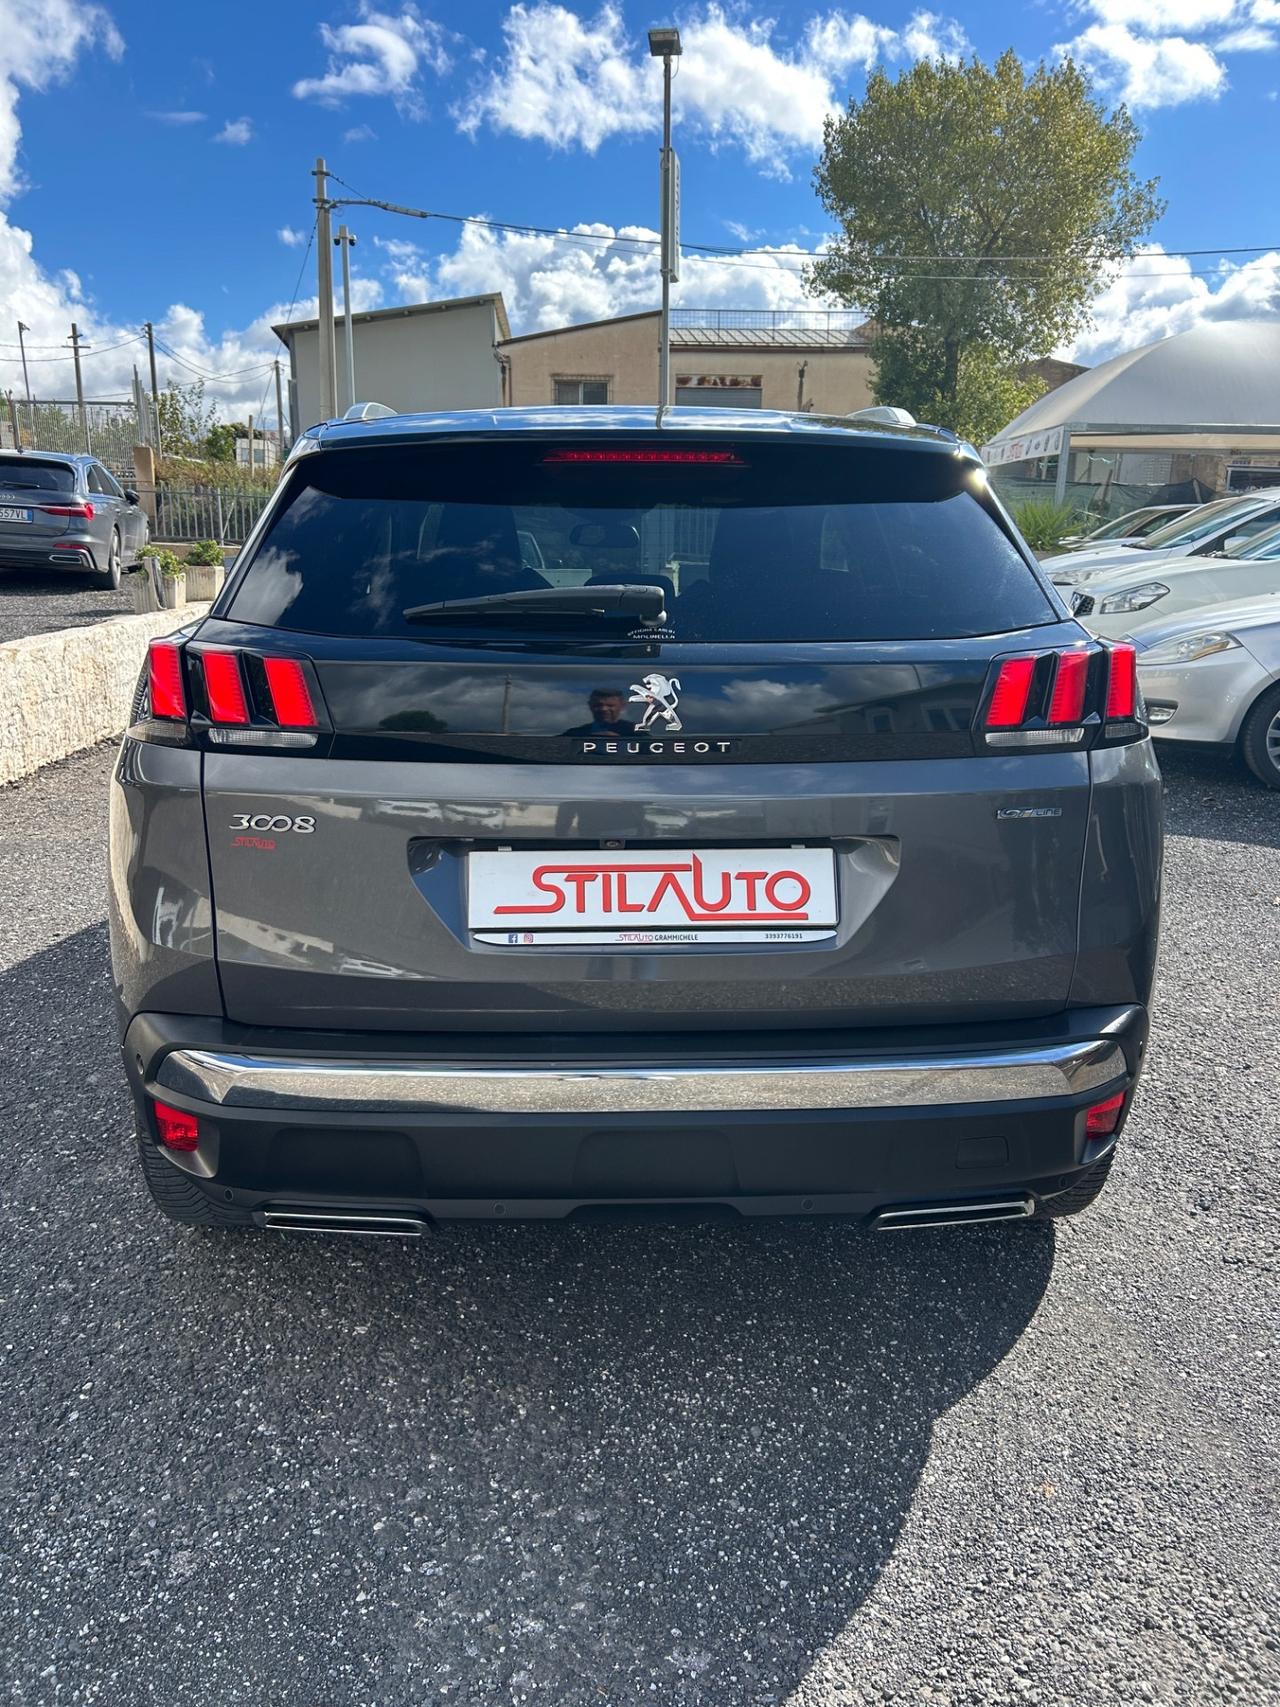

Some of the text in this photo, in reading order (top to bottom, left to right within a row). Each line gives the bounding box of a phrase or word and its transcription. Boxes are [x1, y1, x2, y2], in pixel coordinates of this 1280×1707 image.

[583, 742, 731, 753] PEUGEOT
[229, 814, 315, 833] 3008
[493, 852, 811, 921] STILAUTO
[615, 933, 654, 941] STILAUTO
